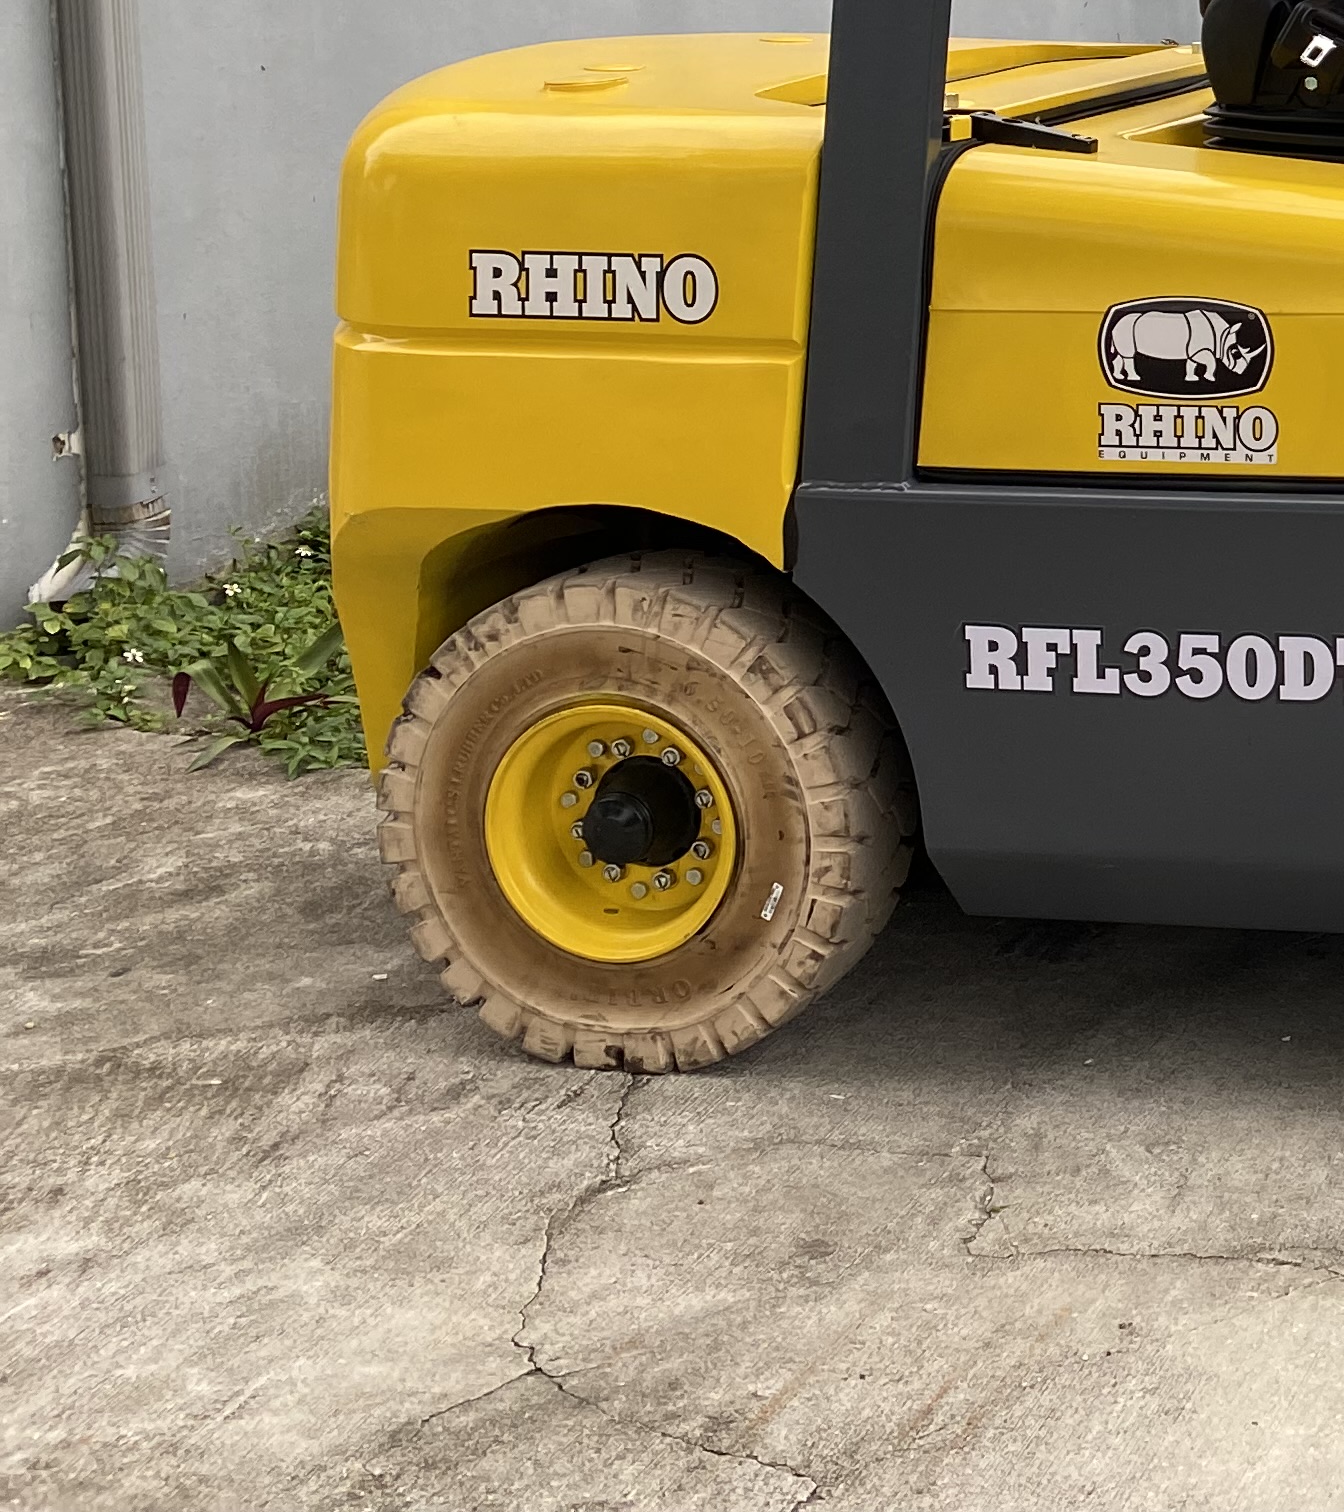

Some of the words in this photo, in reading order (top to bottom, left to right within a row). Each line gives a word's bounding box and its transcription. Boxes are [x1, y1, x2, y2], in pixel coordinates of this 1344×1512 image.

[469, 250, 719, 325] RHINO
[1098, 402, 1280, 452] RHINO
[1098, 450, 1275, 463] EQUIPMENT
